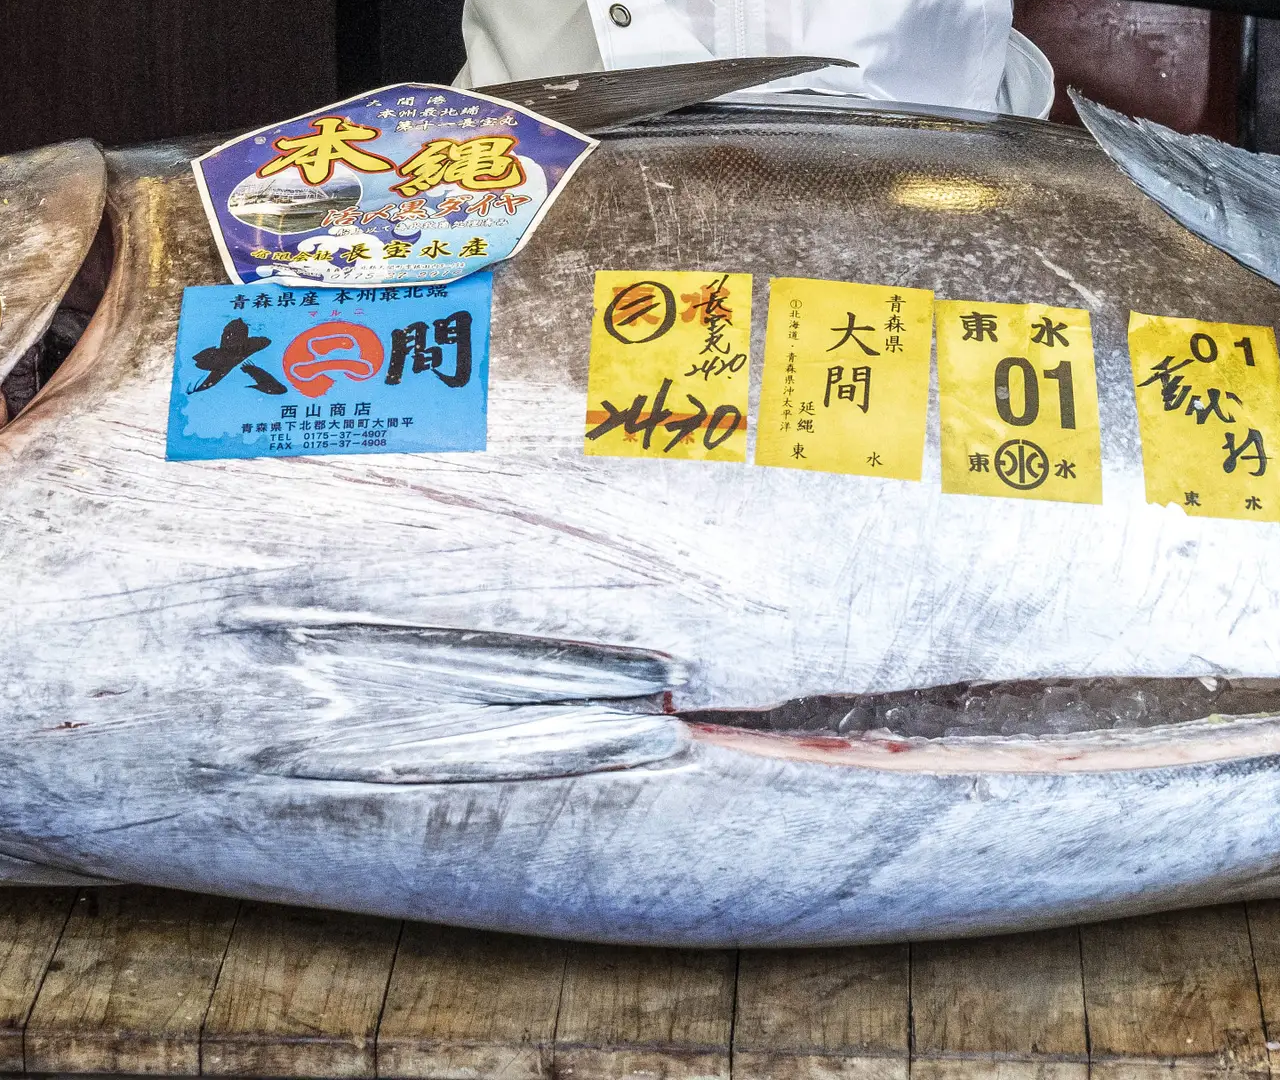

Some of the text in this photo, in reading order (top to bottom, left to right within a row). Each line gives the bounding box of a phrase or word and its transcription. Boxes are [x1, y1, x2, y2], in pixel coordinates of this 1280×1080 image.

[366, 95, 447, 107] 大間港
[257, 116, 526, 198] 本縄
[250, 237, 489, 263] 有限会社 長宝水産
[230, 285, 449, 310] 青森県産 本州最北端
[884, 294, 907, 354] 青森県
[1189, 332, 1256, 367] 01
[824, 311, 881, 414] 大間
[994, 356, 1077, 430] 01
[281, 402, 372, 419] 西山商店
[241, 417, 414, 434] 青森県下北郡大間町大間平
[303, 430, 387, 440] 0175-37-4907
[270, 439, 387, 451] FAX 0175-37-4908
[791, 443, 883, 467] 東 水
